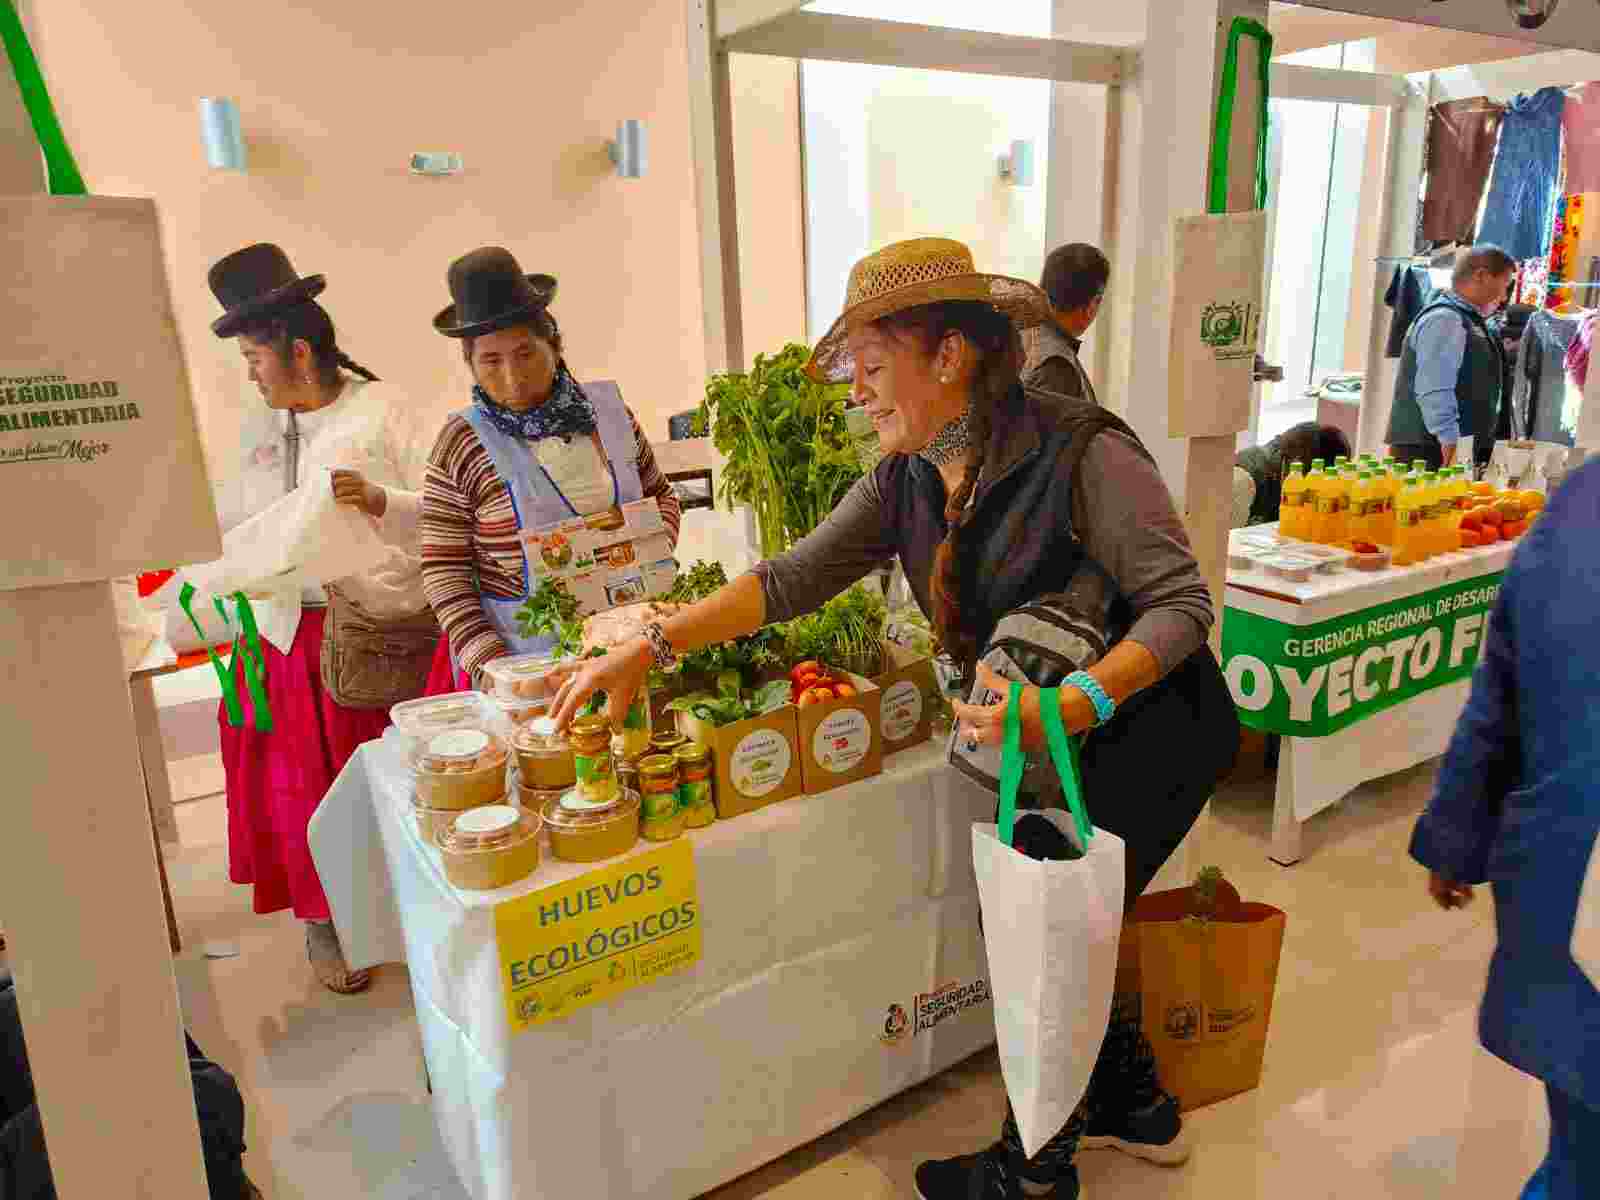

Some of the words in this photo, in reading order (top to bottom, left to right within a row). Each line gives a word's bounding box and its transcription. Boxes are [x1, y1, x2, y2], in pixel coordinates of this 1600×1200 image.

[1283, 626, 1363, 657] GERENCIA
[1367, 603, 1433, 638] REGIONAL
[1435, 597, 1452, 617] DE
[1222, 626, 1442, 722] OYECTO
[538, 865, 663, 928] HUEVOS
[511, 901, 696, 987] ECOLÓGICOS
